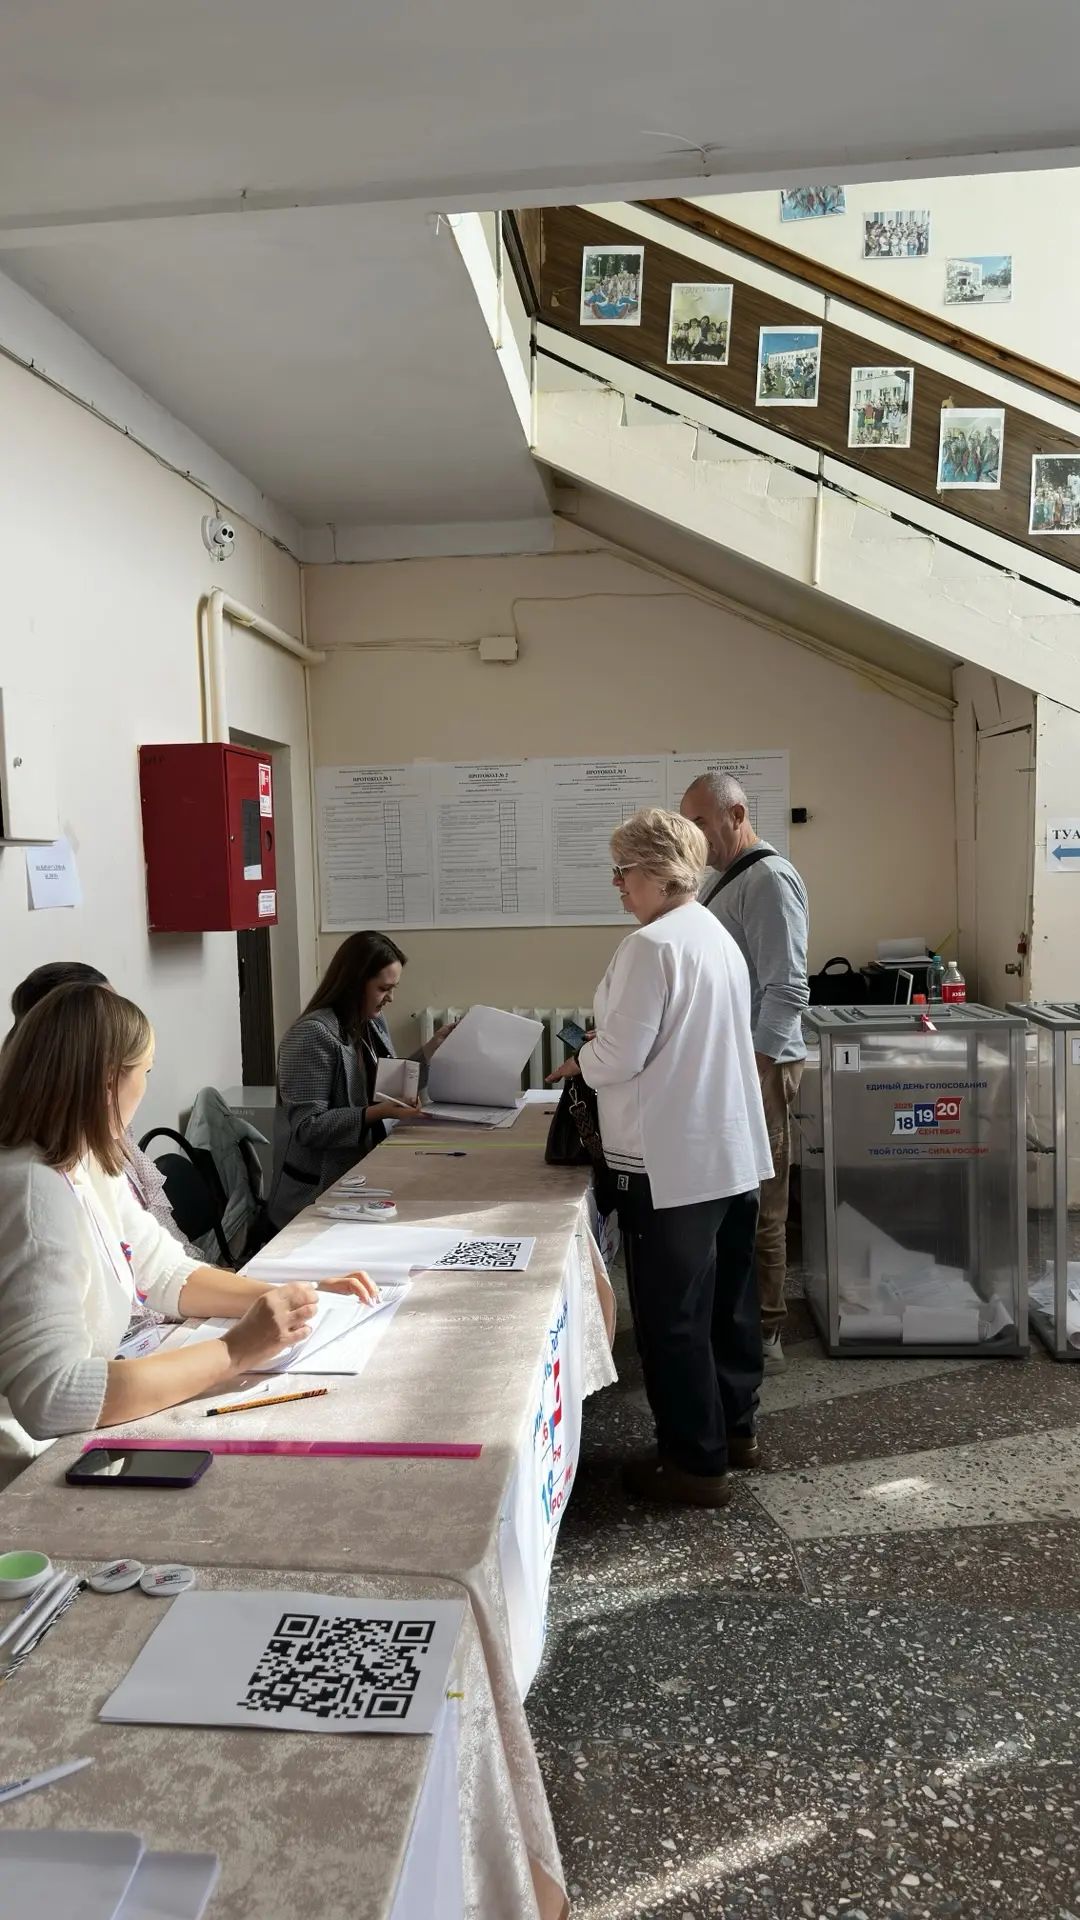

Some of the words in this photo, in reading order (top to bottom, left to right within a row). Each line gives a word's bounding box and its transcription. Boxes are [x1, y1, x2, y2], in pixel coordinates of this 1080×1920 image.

[843, 1050, 851, 1065] 1
[866, 1081, 901, 1091] ЕДИНЫЙ
[902, 1083, 924, 1091] ДЕНЬ
[925, 1081, 988, 1090] ГОЛОСОВАНИЯ
[936, 1102, 958, 1116] 20
[916, 1109, 934, 1123] 19
[896, 1117, 913, 1130] 18
[918, 1127, 961, 1136] СЕНТЯБРЯ
[869, 1147, 891, 1156] ТВОЙ
[892, 1148, 920, 1156] ГОЛОС
[928, 1147, 951, 1155] СИЛА
